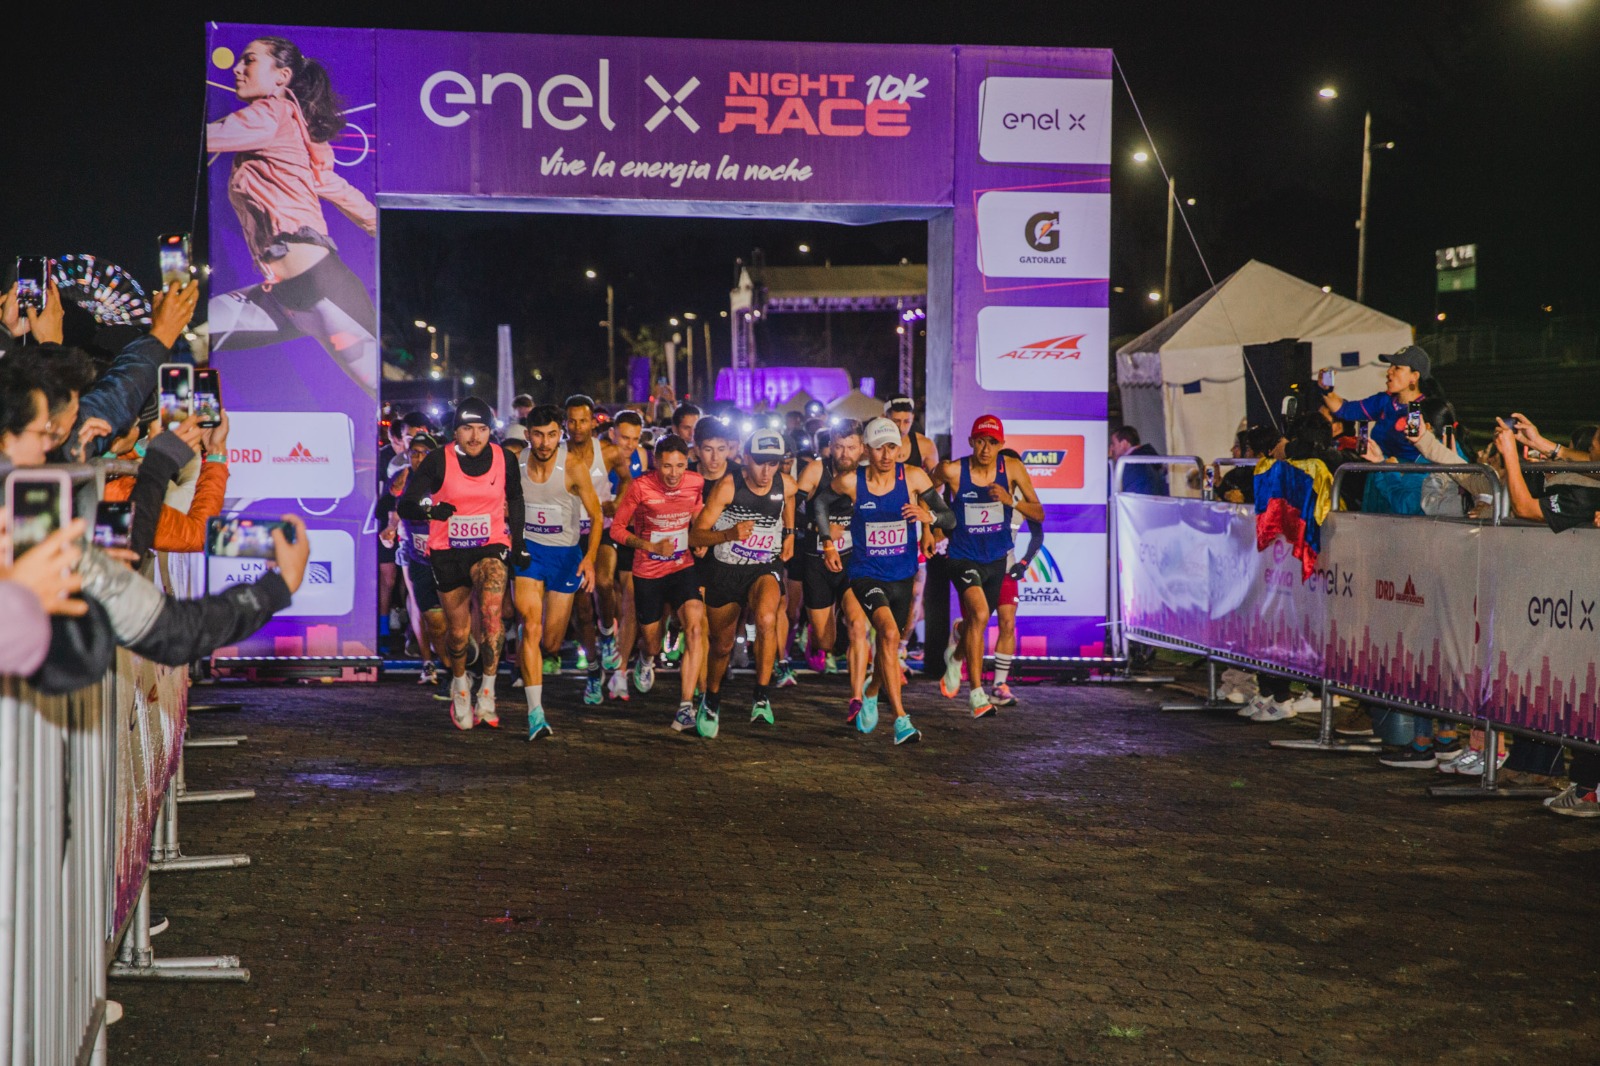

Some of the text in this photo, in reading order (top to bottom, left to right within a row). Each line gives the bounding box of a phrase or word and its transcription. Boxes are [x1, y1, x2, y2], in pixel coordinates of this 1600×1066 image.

[420, 58, 616, 132] enel
[729, 71, 929, 106] NIGHT 10K
[718, 95, 912, 137] RACE
[1002, 108, 1060, 131] enel
[540, 146, 587, 177] Vive
[591, 151, 616, 178] la
[715, 154, 740, 181] la
[743, 157, 814, 182] noche
[1019, 256, 1067, 264] GATORADE
[997, 350, 1081, 360] ALTRA
[226, 448, 263, 463] DRD
[1023, 452, 1058, 464] Advil
[537, 511, 546, 525] 5
[980, 510, 990, 524] 2
[450, 522, 489, 537] 3866
[868, 528, 905, 545] 4307
[1308, 563, 1338, 596] enel
[1018, 594, 1067, 602] CENTRAL
[1375, 579, 1395, 601] IDRD
[1528, 590, 1573, 630] enel
